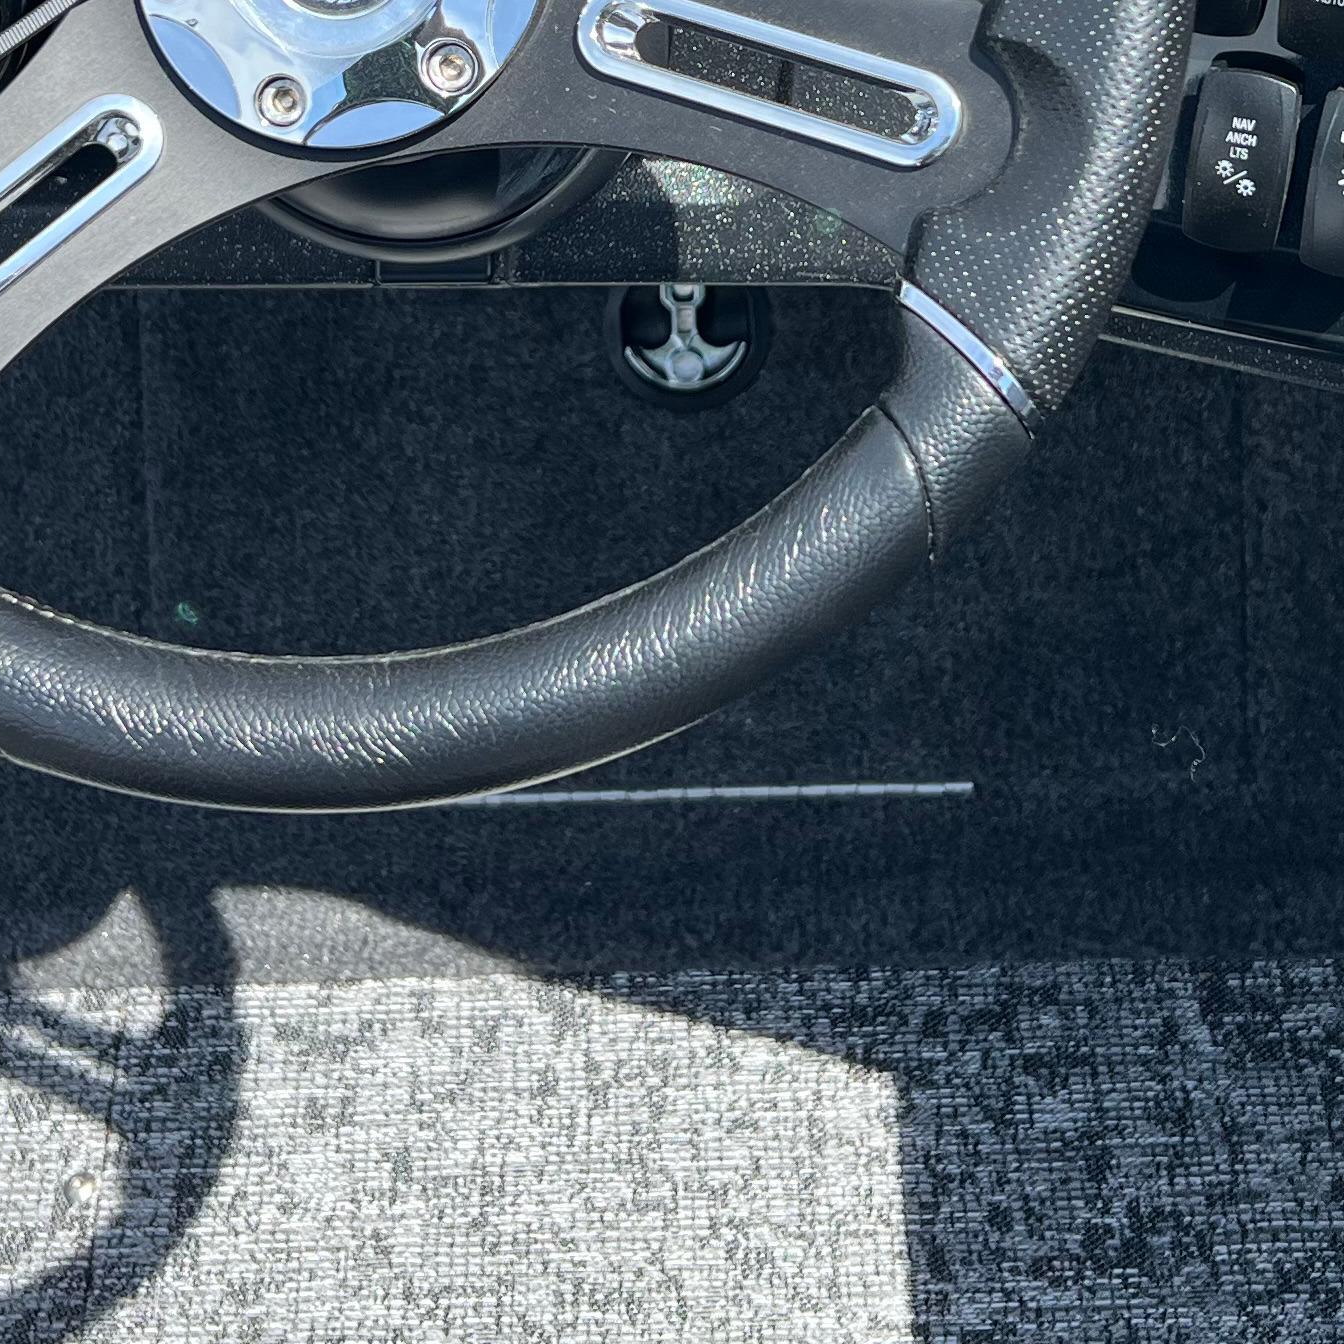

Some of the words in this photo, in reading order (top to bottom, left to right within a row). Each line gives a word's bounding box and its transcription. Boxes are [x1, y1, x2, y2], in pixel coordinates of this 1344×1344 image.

[1232, 116, 1256, 132] NAV
[1225, 131, 1257, 147] ANCH
[1229, 146, 1249, 160] LTS
